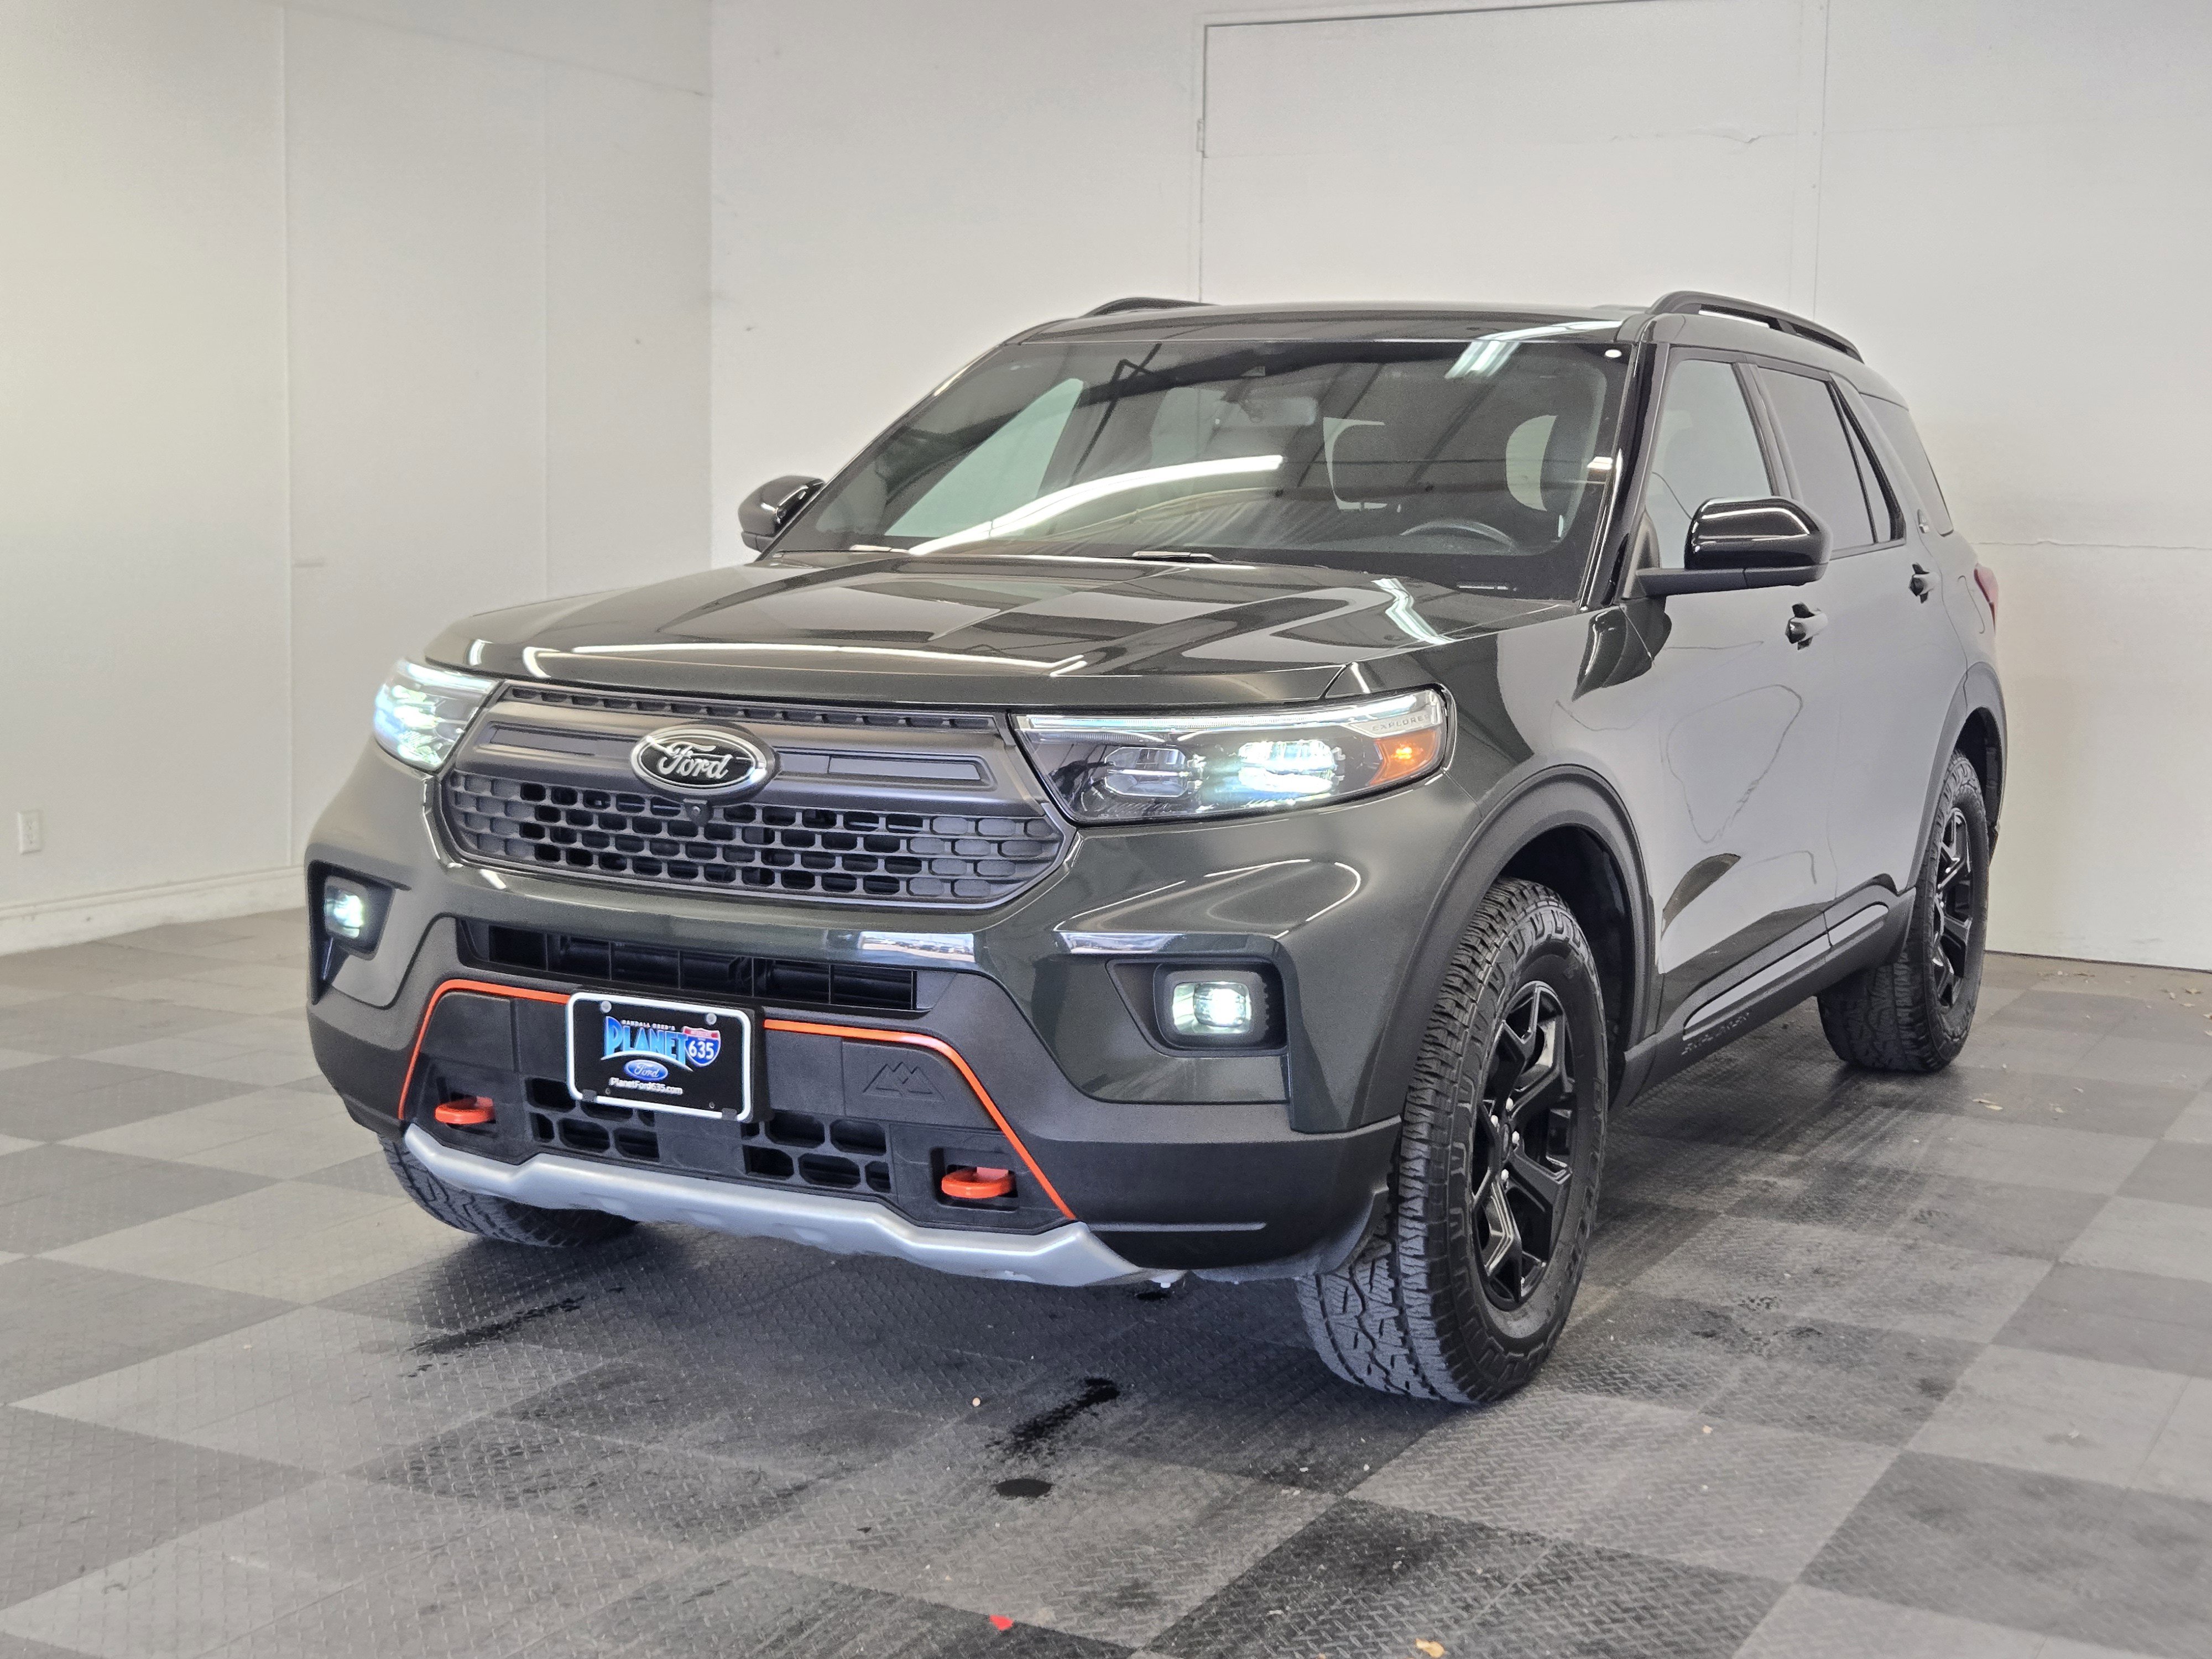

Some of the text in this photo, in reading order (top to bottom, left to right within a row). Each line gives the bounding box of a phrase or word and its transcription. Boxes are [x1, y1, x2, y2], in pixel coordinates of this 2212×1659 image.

[659, 741, 733, 779] Ford
[605, 1015, 688, 1065] PLANET
[688, 1040, 714, 1059] 635
[634, 1062, 660, 1078] Ford
[609, 1077, 683, 1095] PlanetFord635.com
